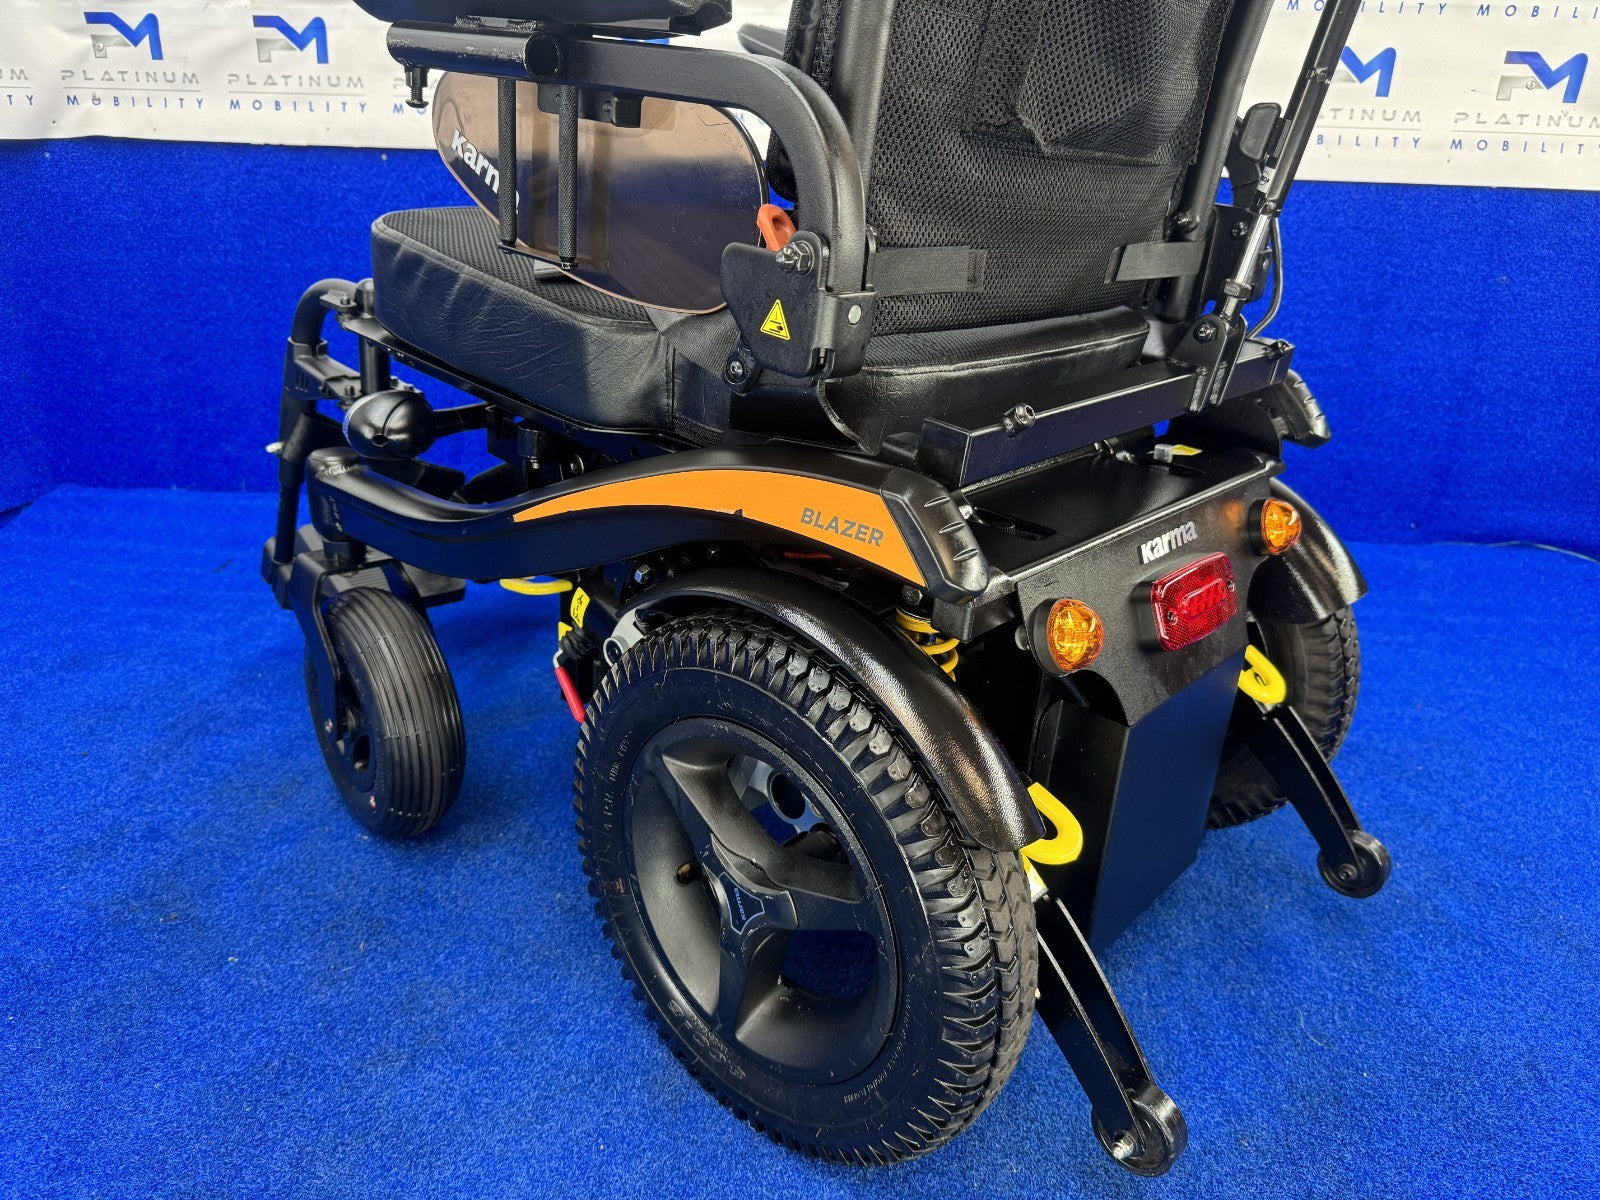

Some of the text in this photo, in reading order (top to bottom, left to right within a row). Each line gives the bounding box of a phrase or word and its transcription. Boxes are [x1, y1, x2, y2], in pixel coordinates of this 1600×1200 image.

[1287, 0, 1447, 15] MOILITY
[1477, 4, 1599, 19] MOBILI
[60, 69, 199, 84] PLATINUM
[227, 74, 364, 88] PLATINUM
[67, 94, 203, 109] MOBILITY
[229, 99, 366, 113] MOBILITY
[1450, 139, 1600, 155] MOBILIT
[800, 507, 884, 547] BLAZER
